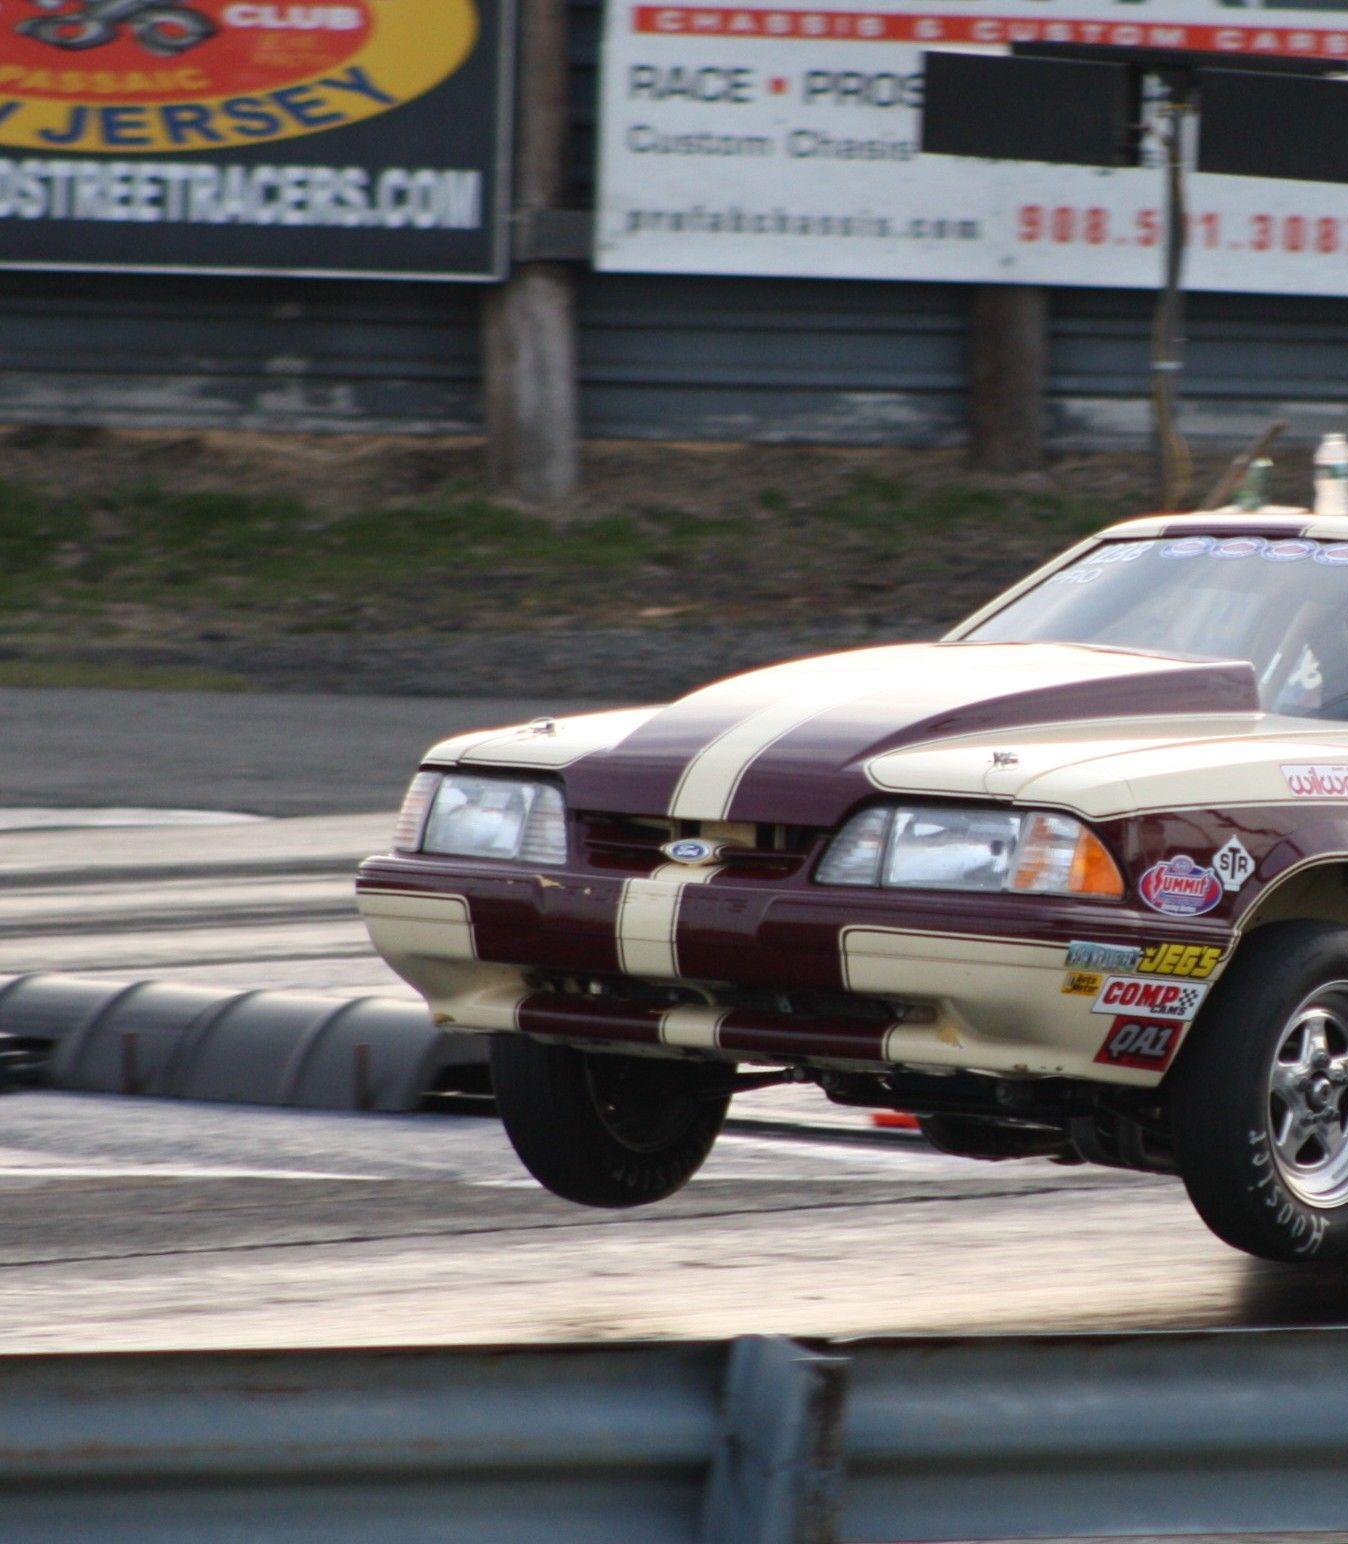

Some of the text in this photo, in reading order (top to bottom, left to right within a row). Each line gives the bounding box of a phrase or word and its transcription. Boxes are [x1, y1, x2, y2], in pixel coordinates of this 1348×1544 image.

[223, 3, 363, 30] CLUB
[654, 9, 887, 38] CHASSIS
[914, 19, 944, 38] &
[972, 19, 1187, 47] CUSTOM
[627, 64, 753, 103] RACE
[37, 66, 402, 146] JERSEY
[627, 125, 774, 155] Custom
[1152, 865, 1209, 899] SUMMIT
[1138, 943, 1222, 978] JEG'S
[1103, 981, 1181, 1009] COMP
[1150, 1005, 1187, 1016] CAMS
[1110, 1023, 1174, 1058] QA1
